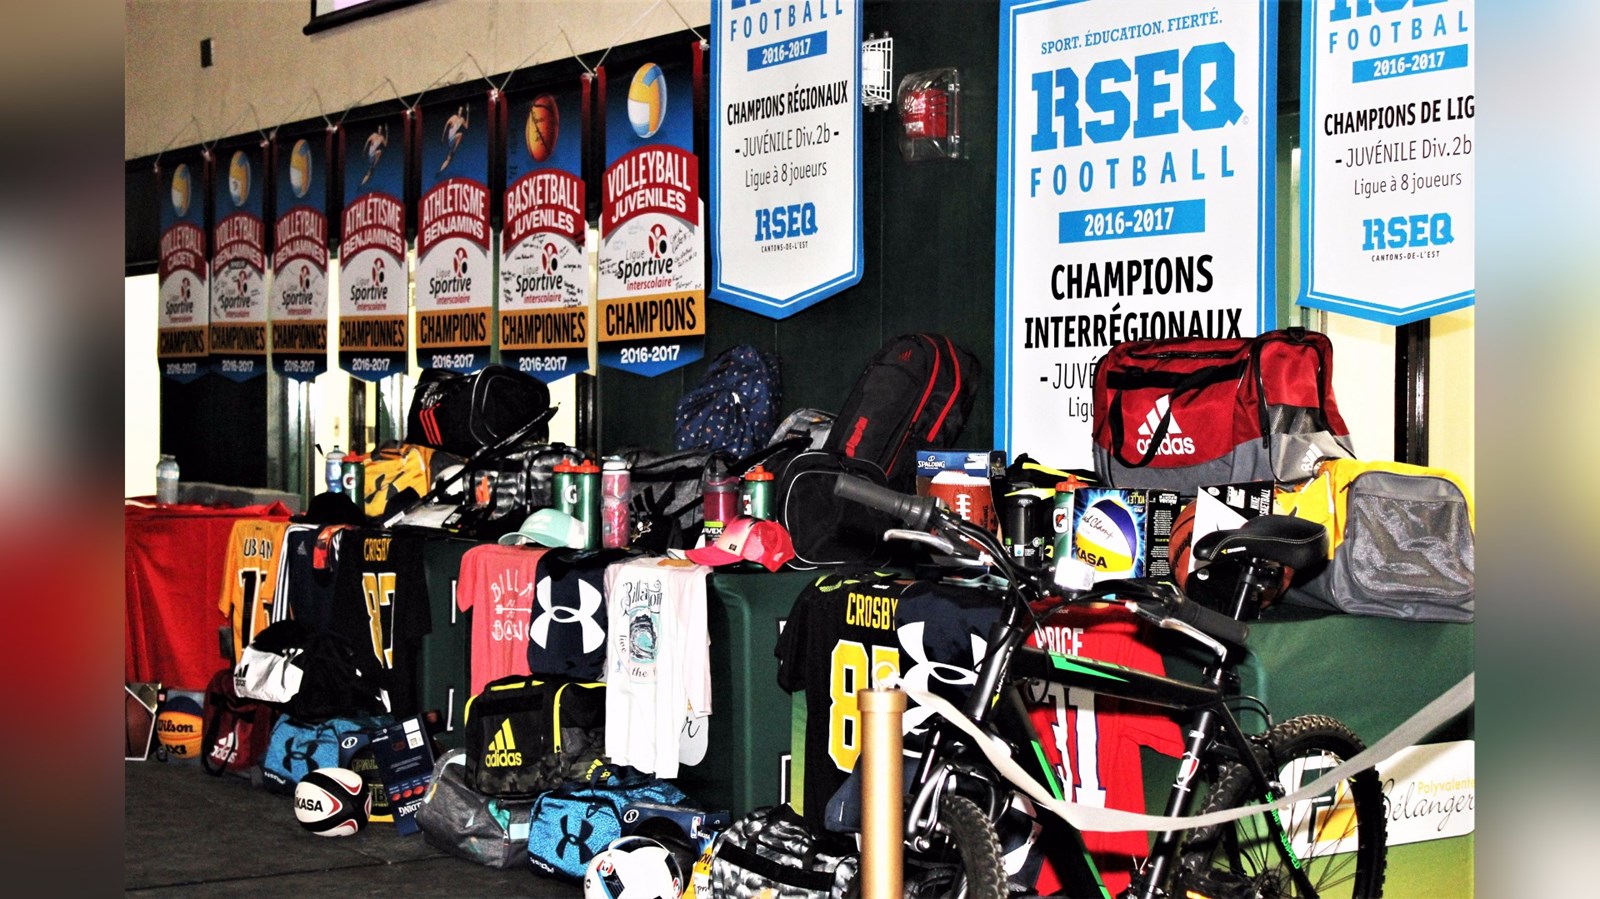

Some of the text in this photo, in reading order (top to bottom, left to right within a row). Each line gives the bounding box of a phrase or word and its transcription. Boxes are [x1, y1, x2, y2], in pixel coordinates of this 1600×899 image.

[1041, 6, 1223, 56] SPORT. ÉDUCATION. FIERTÉ.
[1329, 10, 1468, 54] FOOTBAL
[762, 38, 811, 65] 2016-2017
[1373, 51, 1445, 78] 2016-2017
[727, 80, 848, 126] CHAMPIONS RÉGIONAUX
[1031, 41, 1244, 153] RSEQ
[1324, 102, 1416, 136] CHAMPIONS
[1420, 99, 1441, 125] DE
[743, 130, 793, 157] JUVÉNILE
[796, 122, 830, 149] Div.2b
[1346, 140, 1417, 168] JUVÉNILE
[1422, 134, 1472, 160] Div.2b
[607, 151, 691, 203] VOLLEYBALL
[745, 161, 827, 191] Ligue à 8 joueurs
[1030, 145, 1235, 198] FOOTBALL
[1354, 171, 1462, 199] Ligue à 8 joueurs
[422, 180, 486, 224] ATHLÉTISME
[507, 174, 581, 213] BASKETBALL
[611, 183, 687, 224] JUVÉNILES
[277, 211, 324, 246] VOLLEYBALL
[344, 194, 402, 238] ATHLÉTISME
[511, 205, 575, 241] JUVÉNILES
[755, 202, 818, 241] RSEQ
[1084, 206, 1174, 237] 2016-2017
[216, 216, 261, 252] VOLLEYBALL
[343, 228, 402, 259] BENJAMINES
[424, 215, 484, 249] BENJAMINS
[1362, 212, 1455, 251] RSEQ
[625, 248, 645, 261] Ligue
[761, 241, 809, 253] CANTONS-DE-L'EST
[1371, 250, 1440, 262] CANTONS-DE-L'EST
[515, 272, 563, 295] Sportive
[617, 256, 673, 283] Sportive
[1051, 254, 1214, 301] CHAMPIONS
[282, 291, 313, 309] Sportive
[350, 285, 388, 306] Sportive
[429, 274, 472, 298] Sportive
[523, 291, 562, 303] interscolaire
[626, 279, 673, 291] interscolaire
[420, 311, 487, 343] CHAMPIONS
[502, 310, 586, 345] CHAMPIONNES
[606, 296, 697, 336] CHAMPIONS
[1024, 302, 1242, 349] INTERRÉGIONAUX
[160, 329, 204, 353] CHAMPIONS
[211, 326, 265, 352] CHAMPIONNES
[272, 322, 327, 350] CHAMPIONNES
[340, 320, 405, 347] CHAMPIONNES
[167, 363, 197, 375] 2016-2017
[222, 360, 254, 373] 2016-2017
[284, 359, 315, 373] 2016-2017
[352, 358, 390, 371] 2016-2017
[432, 354, 475, 369] 2016-2017
[519, 356, 568, 372] 2016-2017
[620, 345, 681, 364] 2016-2017
[917, 460, 945, 469] SPALDING
[485, 749, 522, 768] adidas
